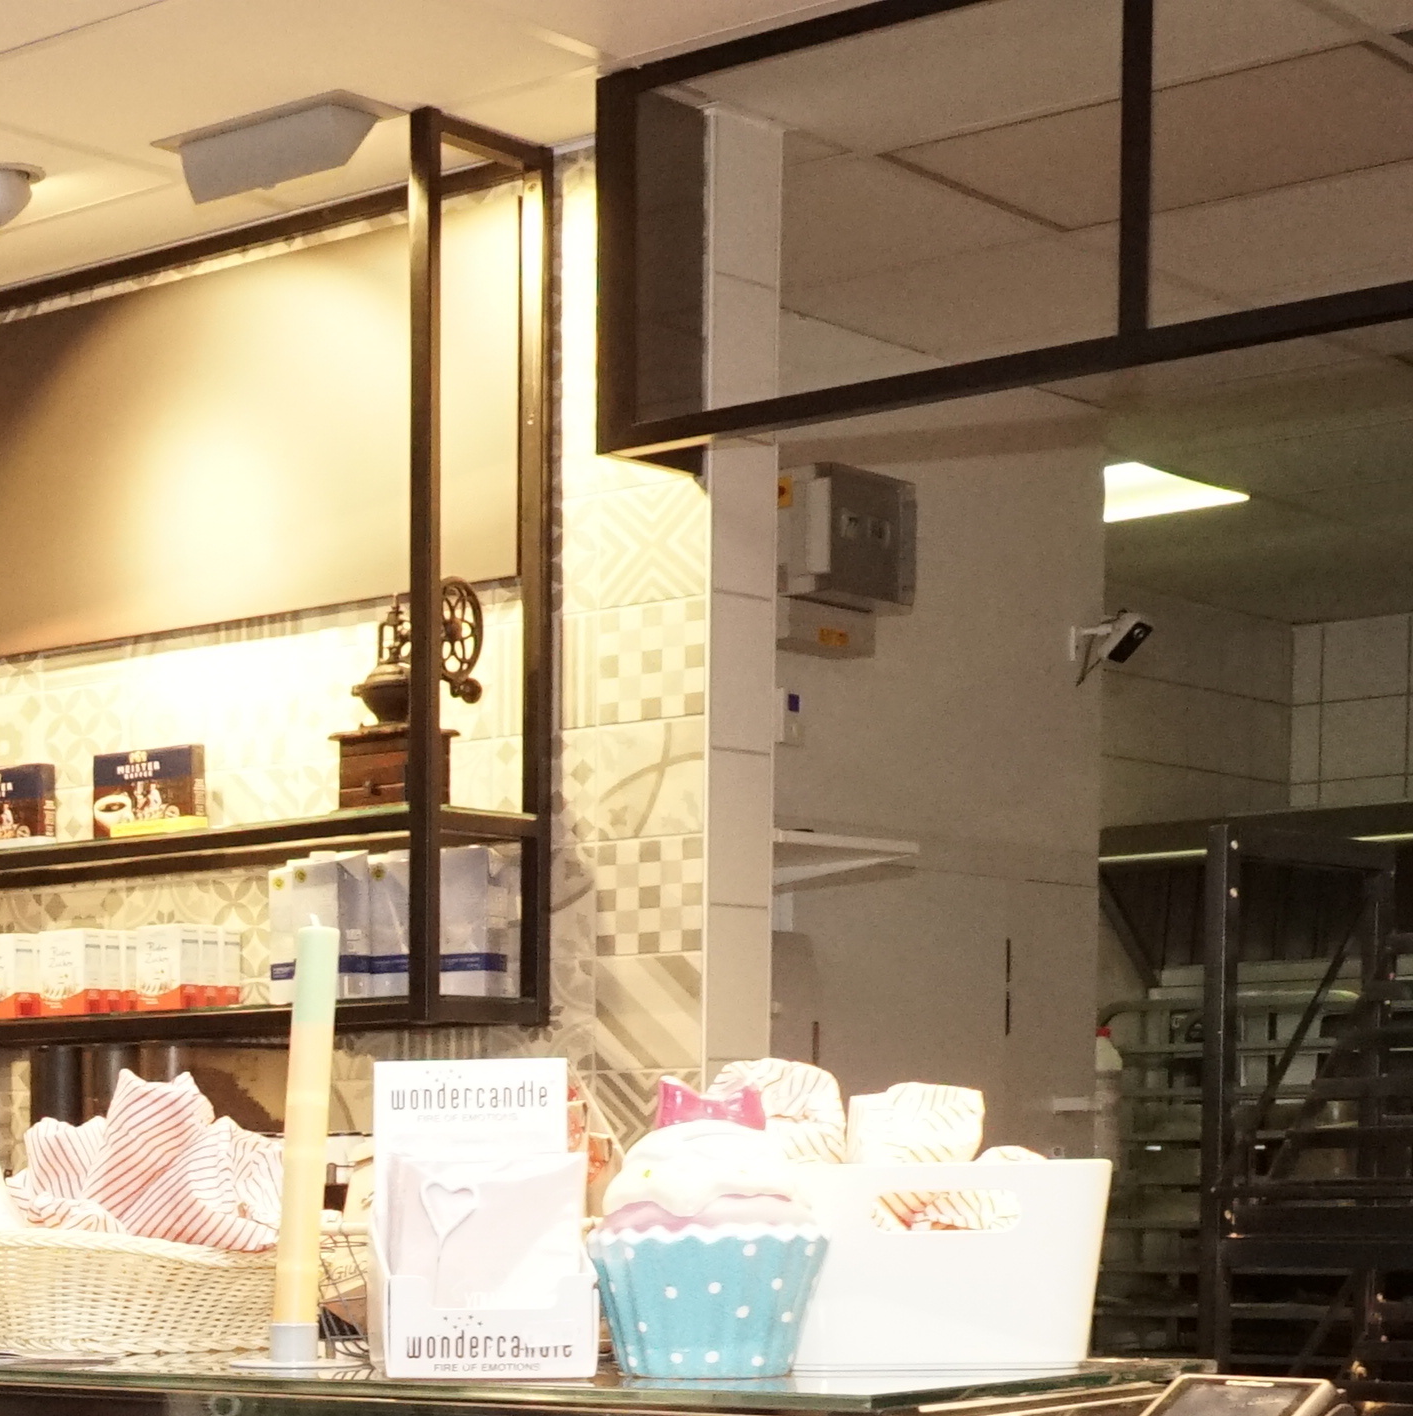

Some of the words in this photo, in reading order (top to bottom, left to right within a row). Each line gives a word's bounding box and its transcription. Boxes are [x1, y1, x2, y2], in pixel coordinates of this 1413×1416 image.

[391, 1081, 548, 1111] wondercandle
[417, 1114, 440, 1123] FIRE
[444, 1114, 459, 1122] OF
[462, 1112, 518, 1122] EMOTIONS
[434, 1364, 458, 1372] FIRE
[462, 1364, 477, 1372] OF
[481, 1363, 540, 1372] EMOTIONS
